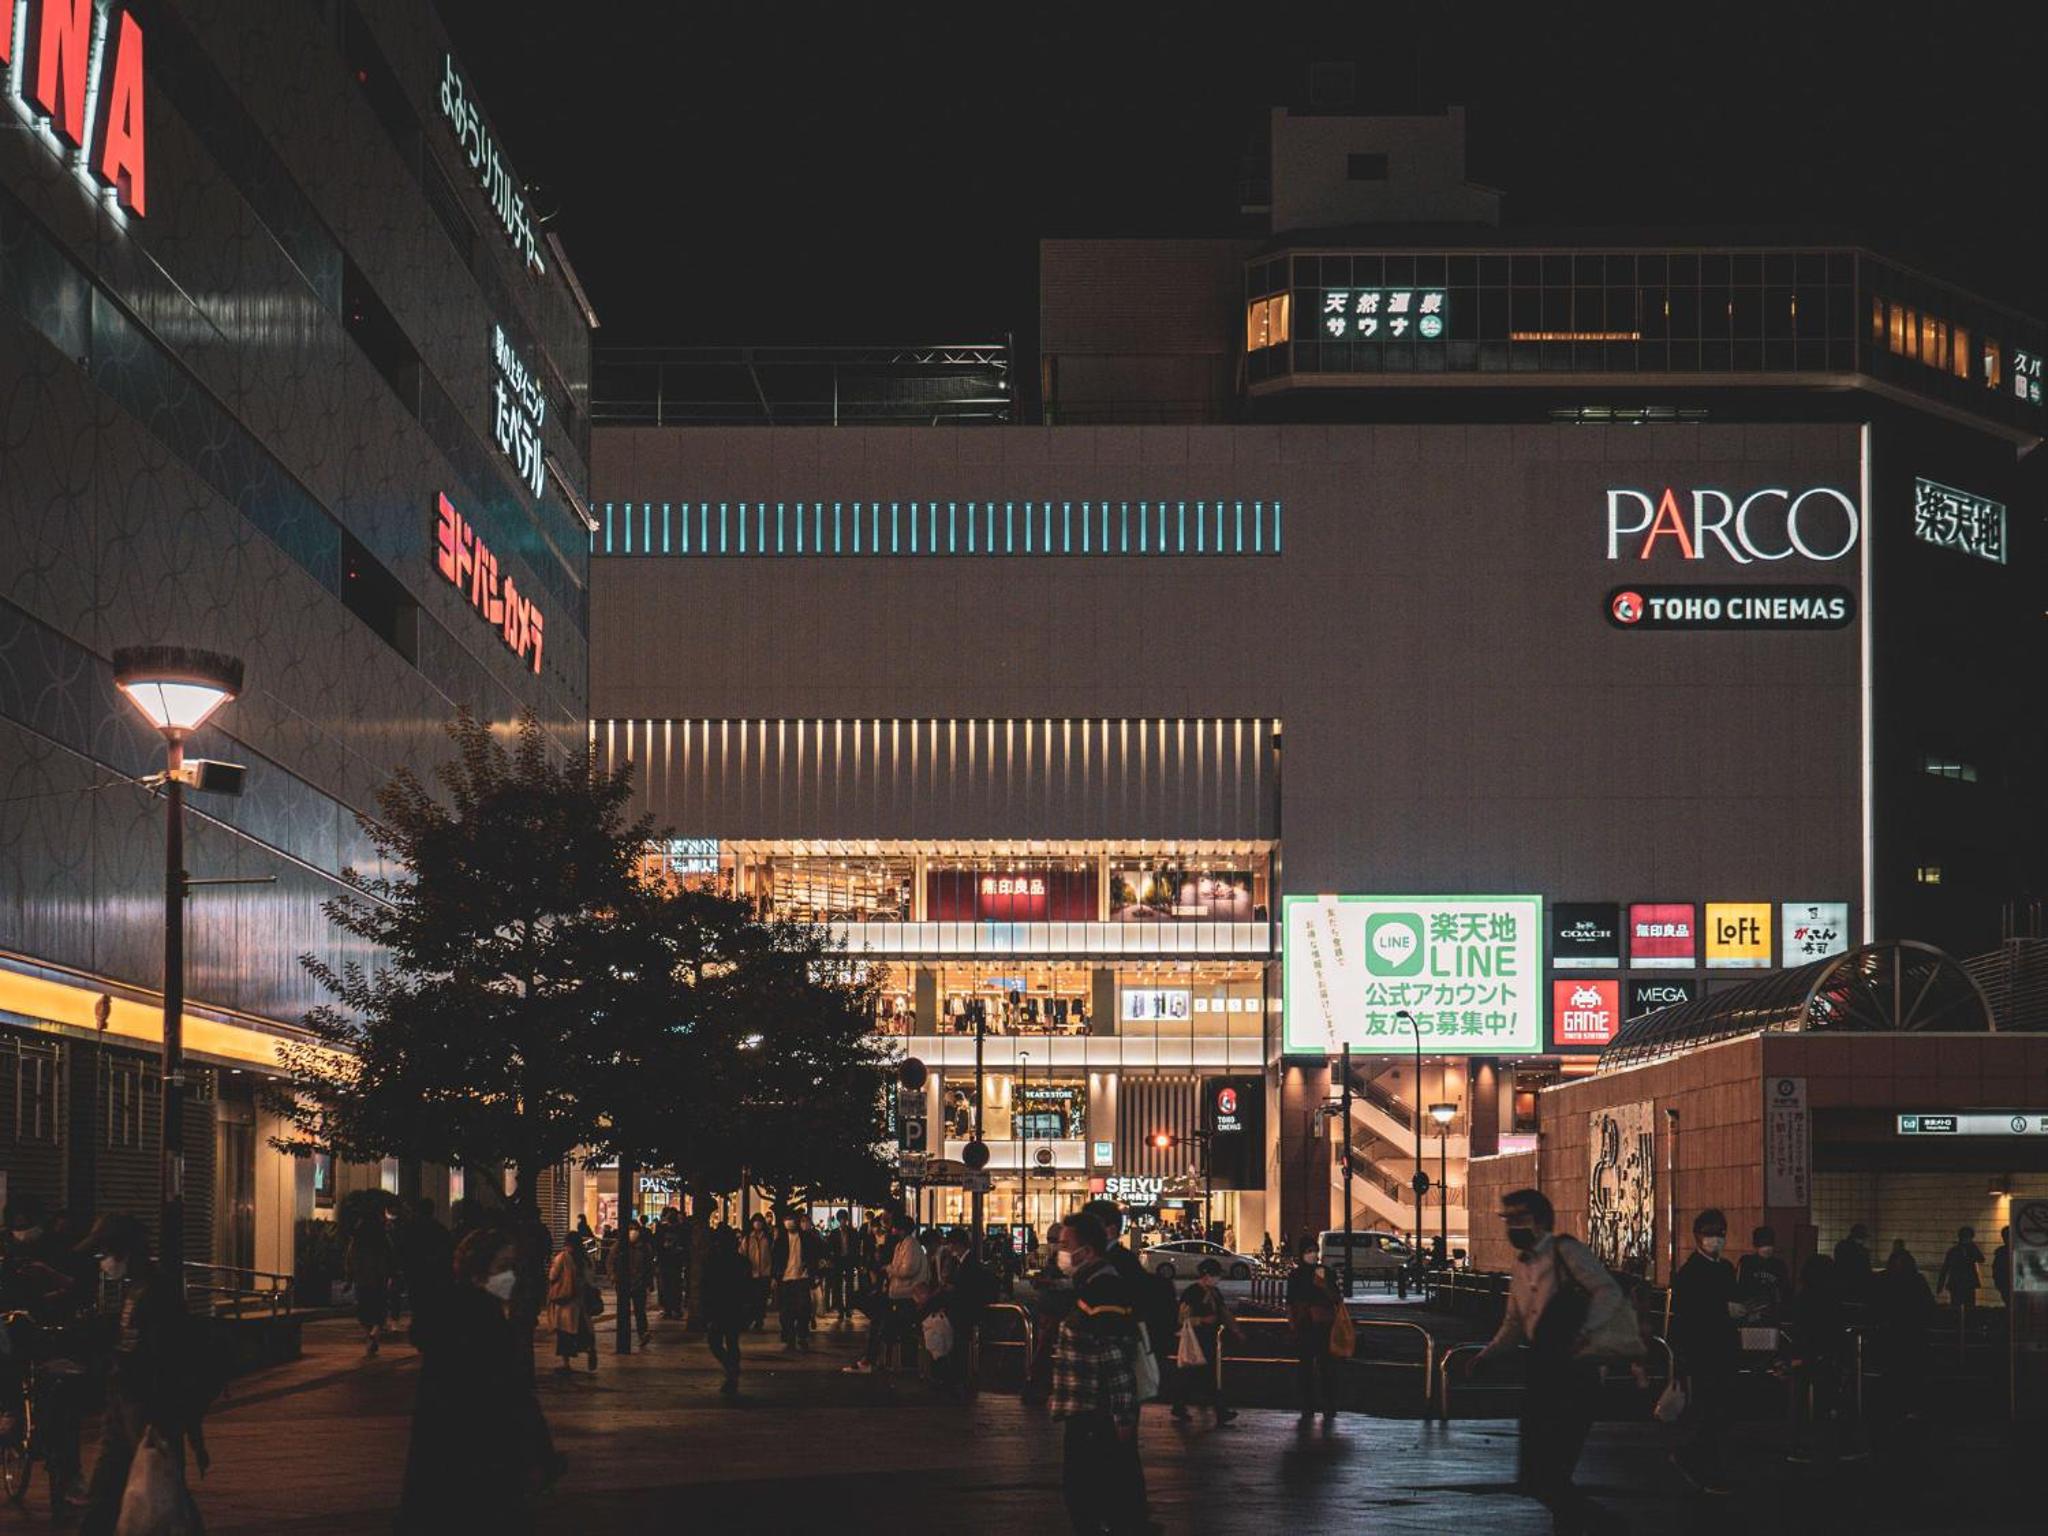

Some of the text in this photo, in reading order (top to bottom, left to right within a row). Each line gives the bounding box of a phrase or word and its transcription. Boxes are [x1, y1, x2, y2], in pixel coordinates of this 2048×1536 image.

[0, 0, 145, 218] NA
[441, 53, 545, 275] よみうりカルチャー
[1323, 292, 1442, 314] 天然温泉
[1326, 317, 1408, 337] サウナ
[1606, 487, 1859, 564] PARCO
[1915, 484, 2003, 562] 楽天地
[438, 490, 544, 675] ヨドバシカメラ
[1649, 598, 1846, 620] TOHO CINEMAS
[1430, 912, 1518, 943] 楽天地
[1560, 930, 1611, 938] COACH
[1636, 923, 1689, 938] 無印良品
[1794, 927, 1837, 941] がってん
[1380, 936, 1410, 949] LINE
[1430, 945, 1518, 978] LINE
[1365, 982, 1518, 1007] 公式アカウント
[1637, 987, 1688, 1001] MEGA
[906, 1121, 922, 1147] P
[1106, 1177, 1163, 1193] SEIYU
